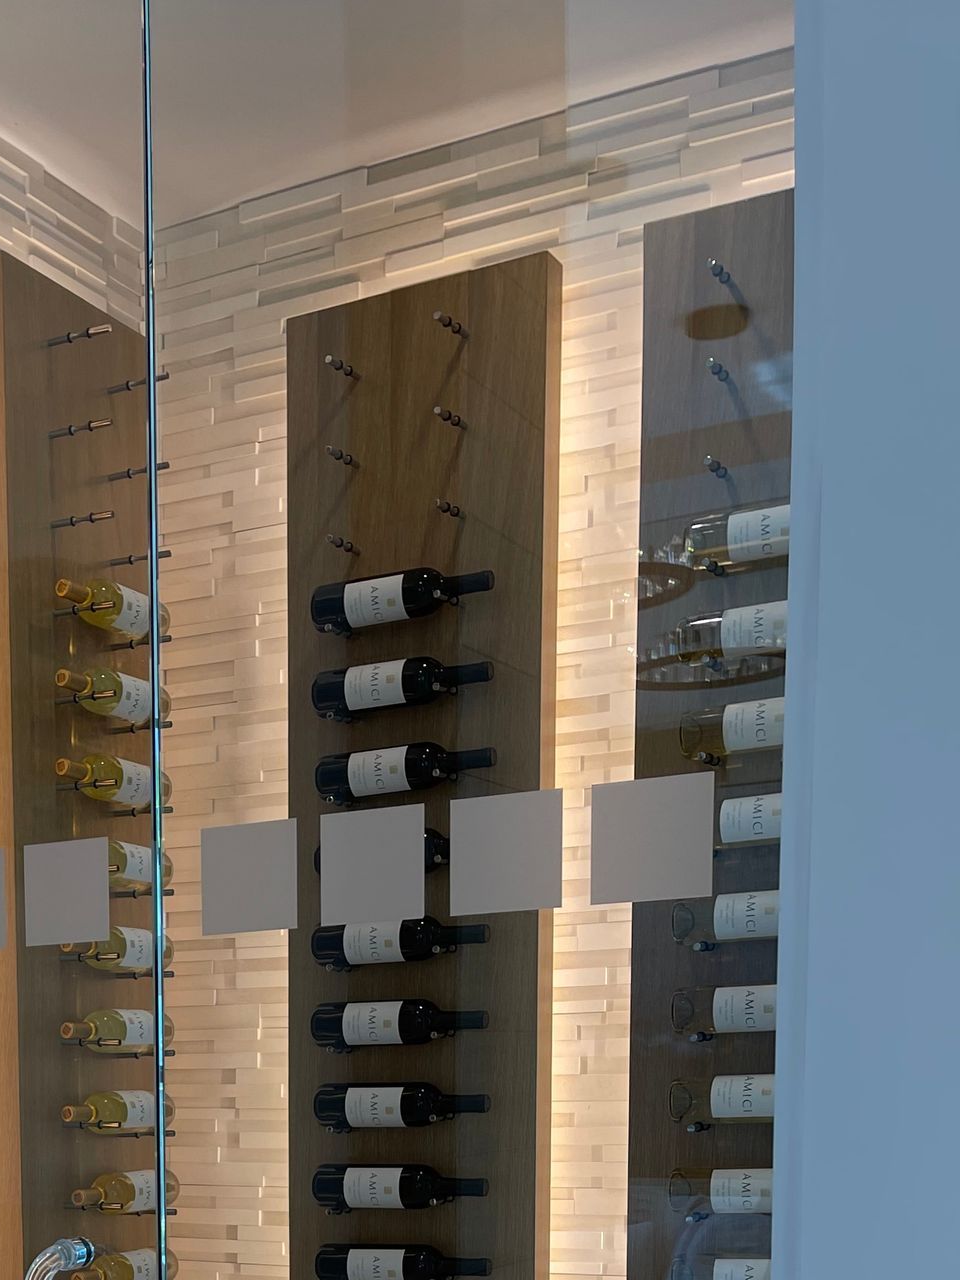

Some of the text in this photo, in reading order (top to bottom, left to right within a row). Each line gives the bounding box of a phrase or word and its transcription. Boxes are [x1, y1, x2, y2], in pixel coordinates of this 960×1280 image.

[761, 514, 773, 555] AMICI
[753, 608, 765, 648] AMICI
[370, 665, 381, 701] AMICI
[755, 702, 768, 742] AMICI
[373, 754, 386, 790] AMICI
[752, 797, 763, 835] AMICI
[745, 894, 757, 933] AMICI
[369, 926, 381, 961] AMICI
[744, 990, 756, 1028] AMICI
[742, 1076, 754, 1112] AMICI
[741, 1172, 753, 1211] AMICI
